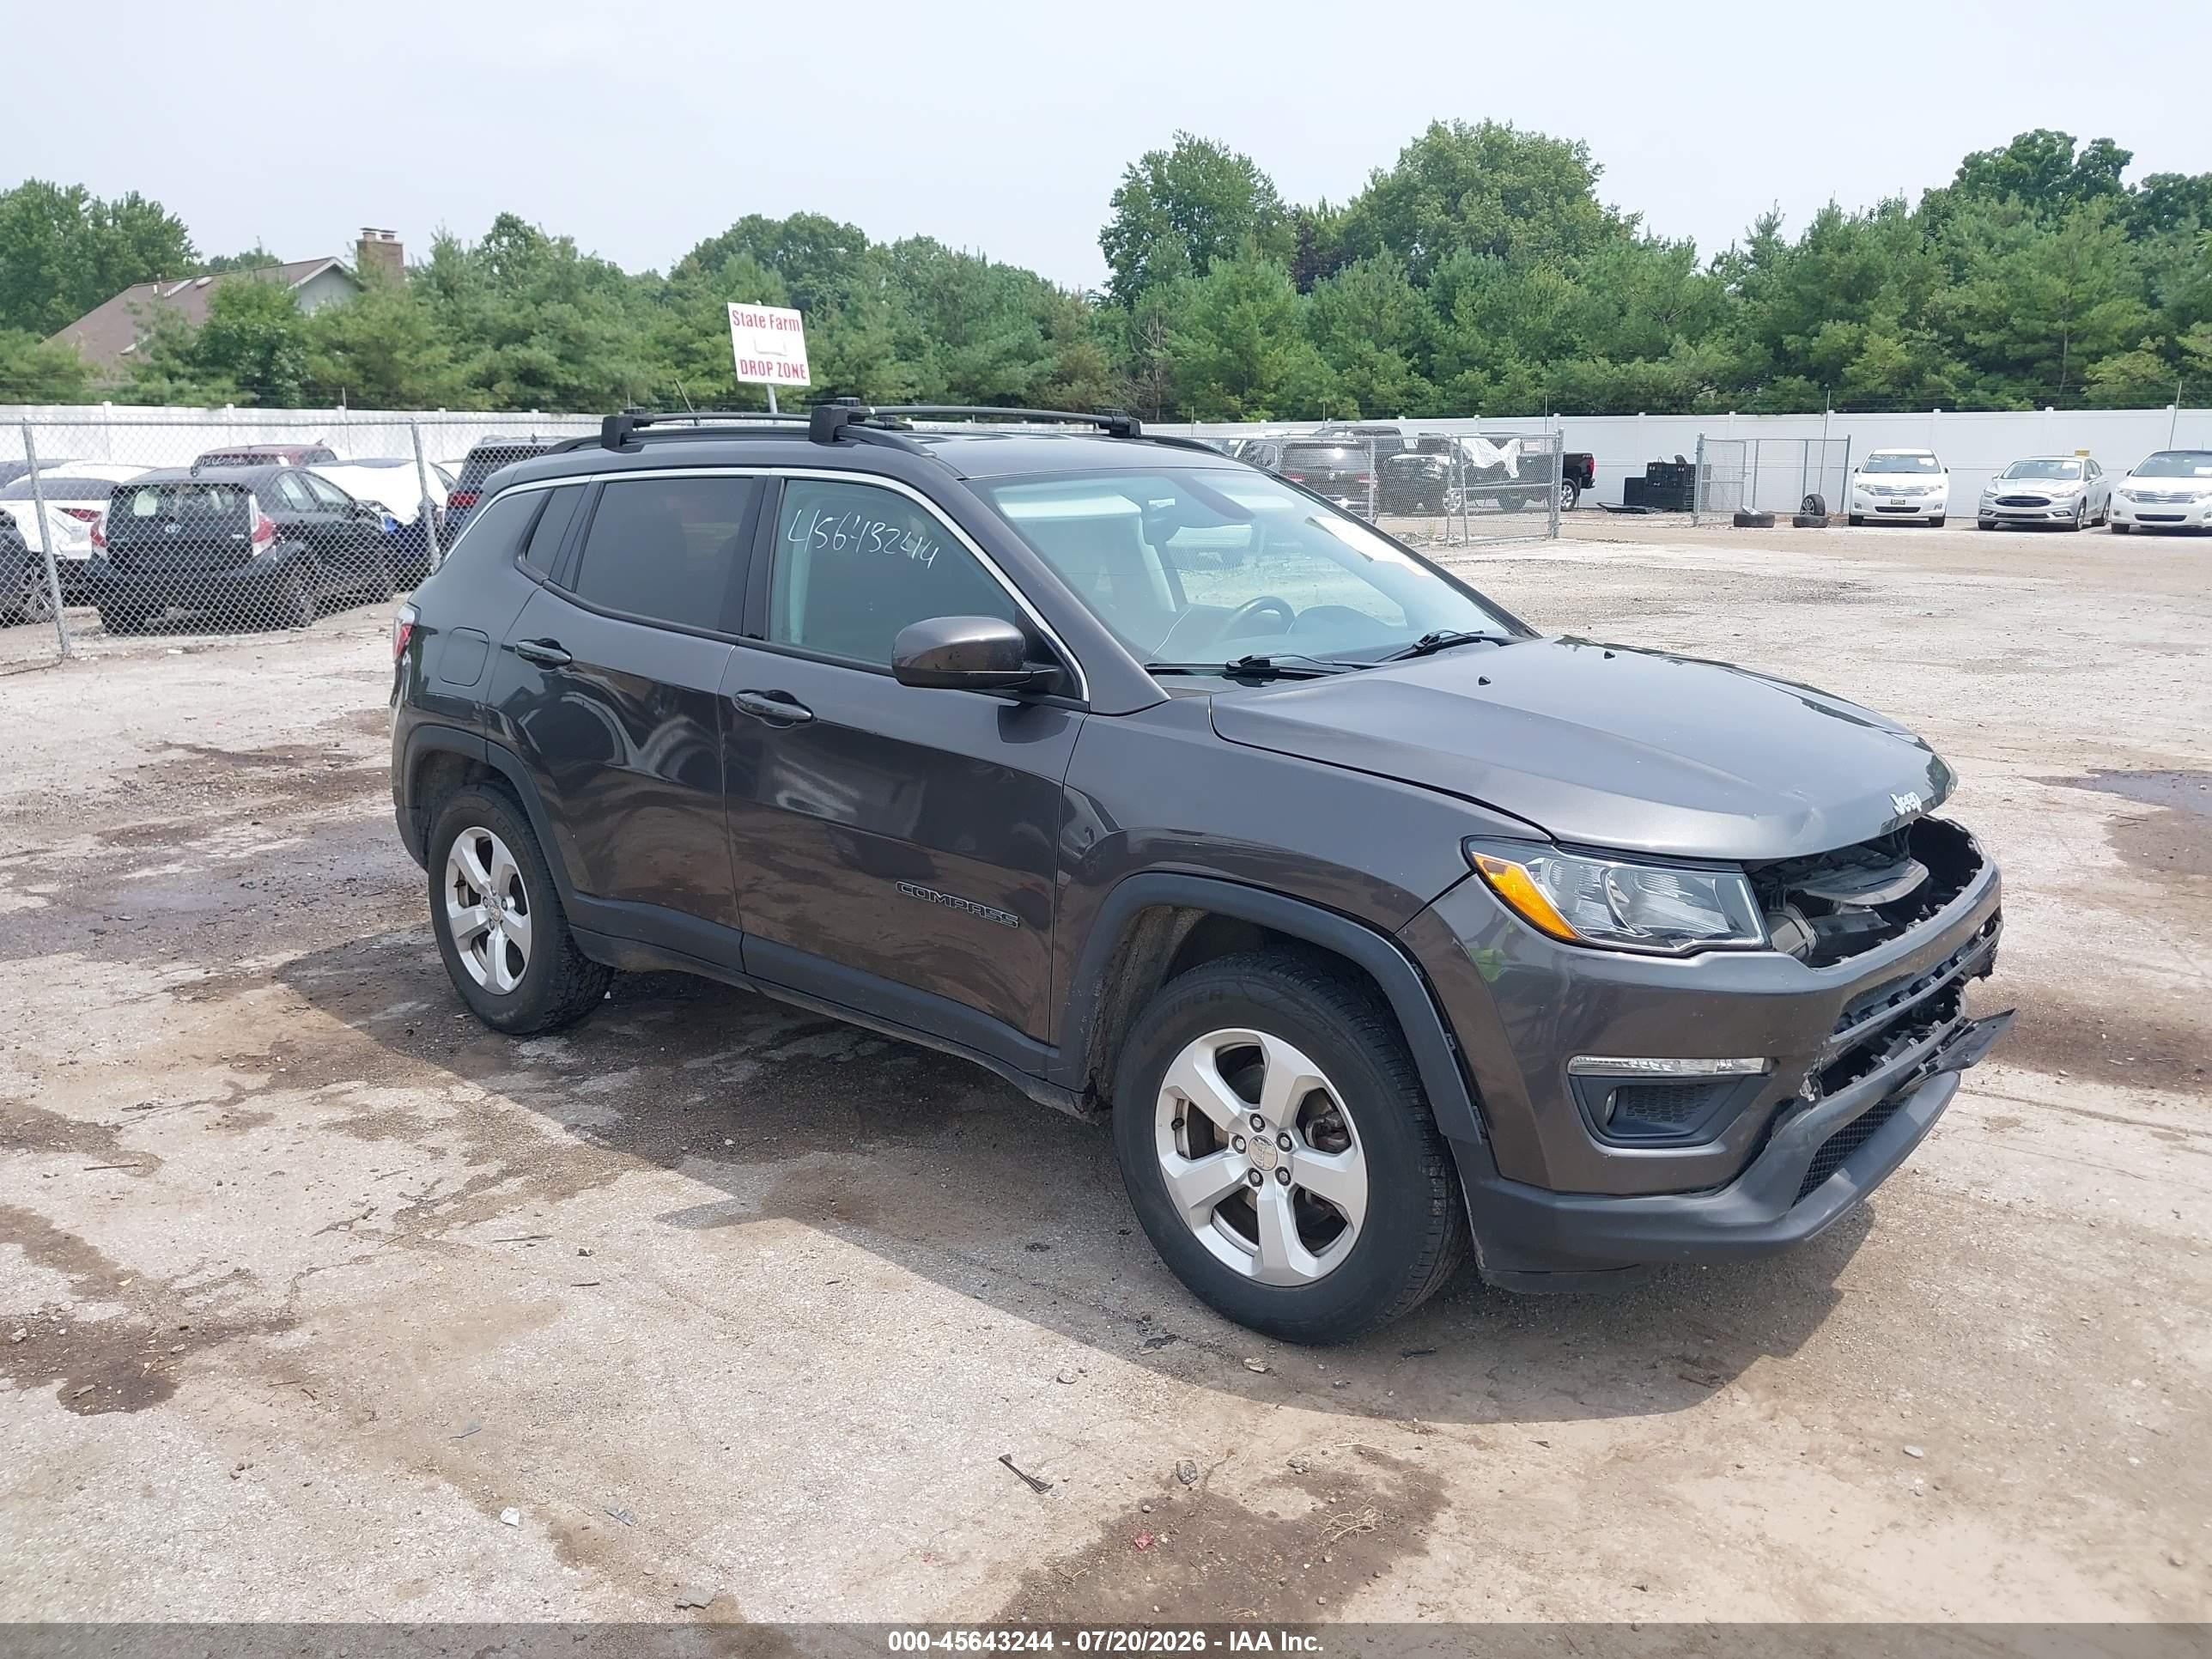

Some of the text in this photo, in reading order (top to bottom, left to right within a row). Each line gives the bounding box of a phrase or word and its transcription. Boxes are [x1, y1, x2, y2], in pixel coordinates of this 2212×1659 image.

[732, 309, 800, 332] State Farm
[739, 359, 807, 380] DROP ZONE
[1889, 789, 1923, 816] Jeep
[895, 880, 1020, 928] COMPASS
